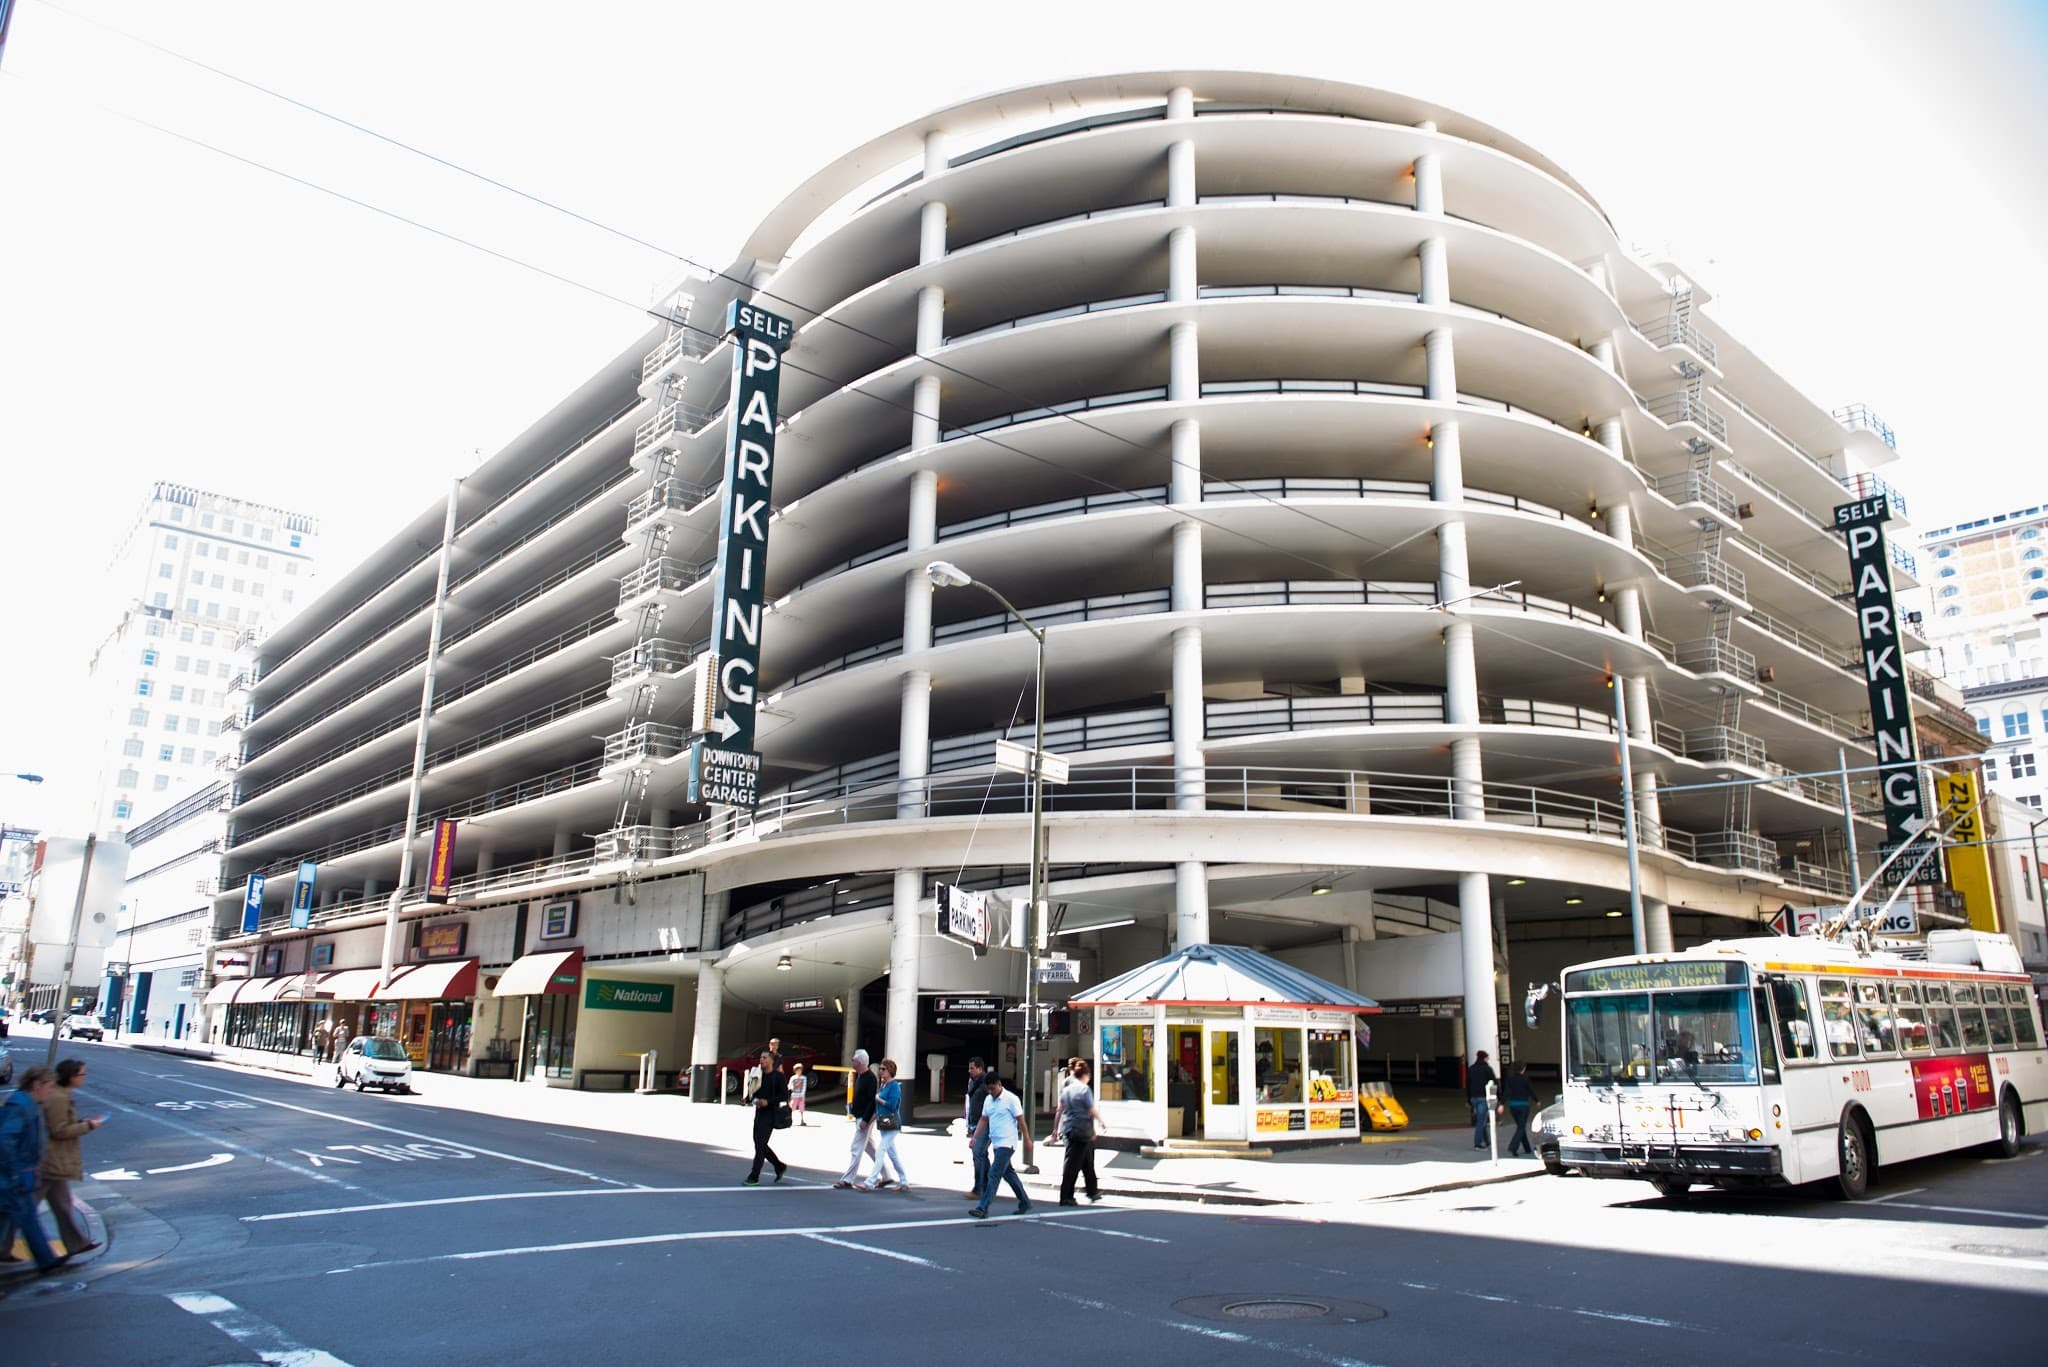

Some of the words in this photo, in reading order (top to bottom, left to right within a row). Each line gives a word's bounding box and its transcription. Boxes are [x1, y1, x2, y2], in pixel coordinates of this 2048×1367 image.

[739, 307, 788, 339] SELF
[720, 338, 778, 706] PARKING
[1838, 500, 1885, 525] SELF
[1849, 525, 1918, 807] PARKING
[703, 747, 759, 771] DOWNTOWN
[703, 765, 756, 788] CENTER
[701, 783, 756, 805] GARAGE
[1948, 782, 1977, 847] Hertz
[1889, 856, 1935, 869] ENTR
[951, 906, 977, 937] PARKING
[1863, 907, 1880, 918] ELF
[1587, 972, 1609, 991] 45
[1610, 968, 1648, 980] UNION
[1665, 962, 1726, 977] STOCKTON
[613, 988, 663, 1005] National
